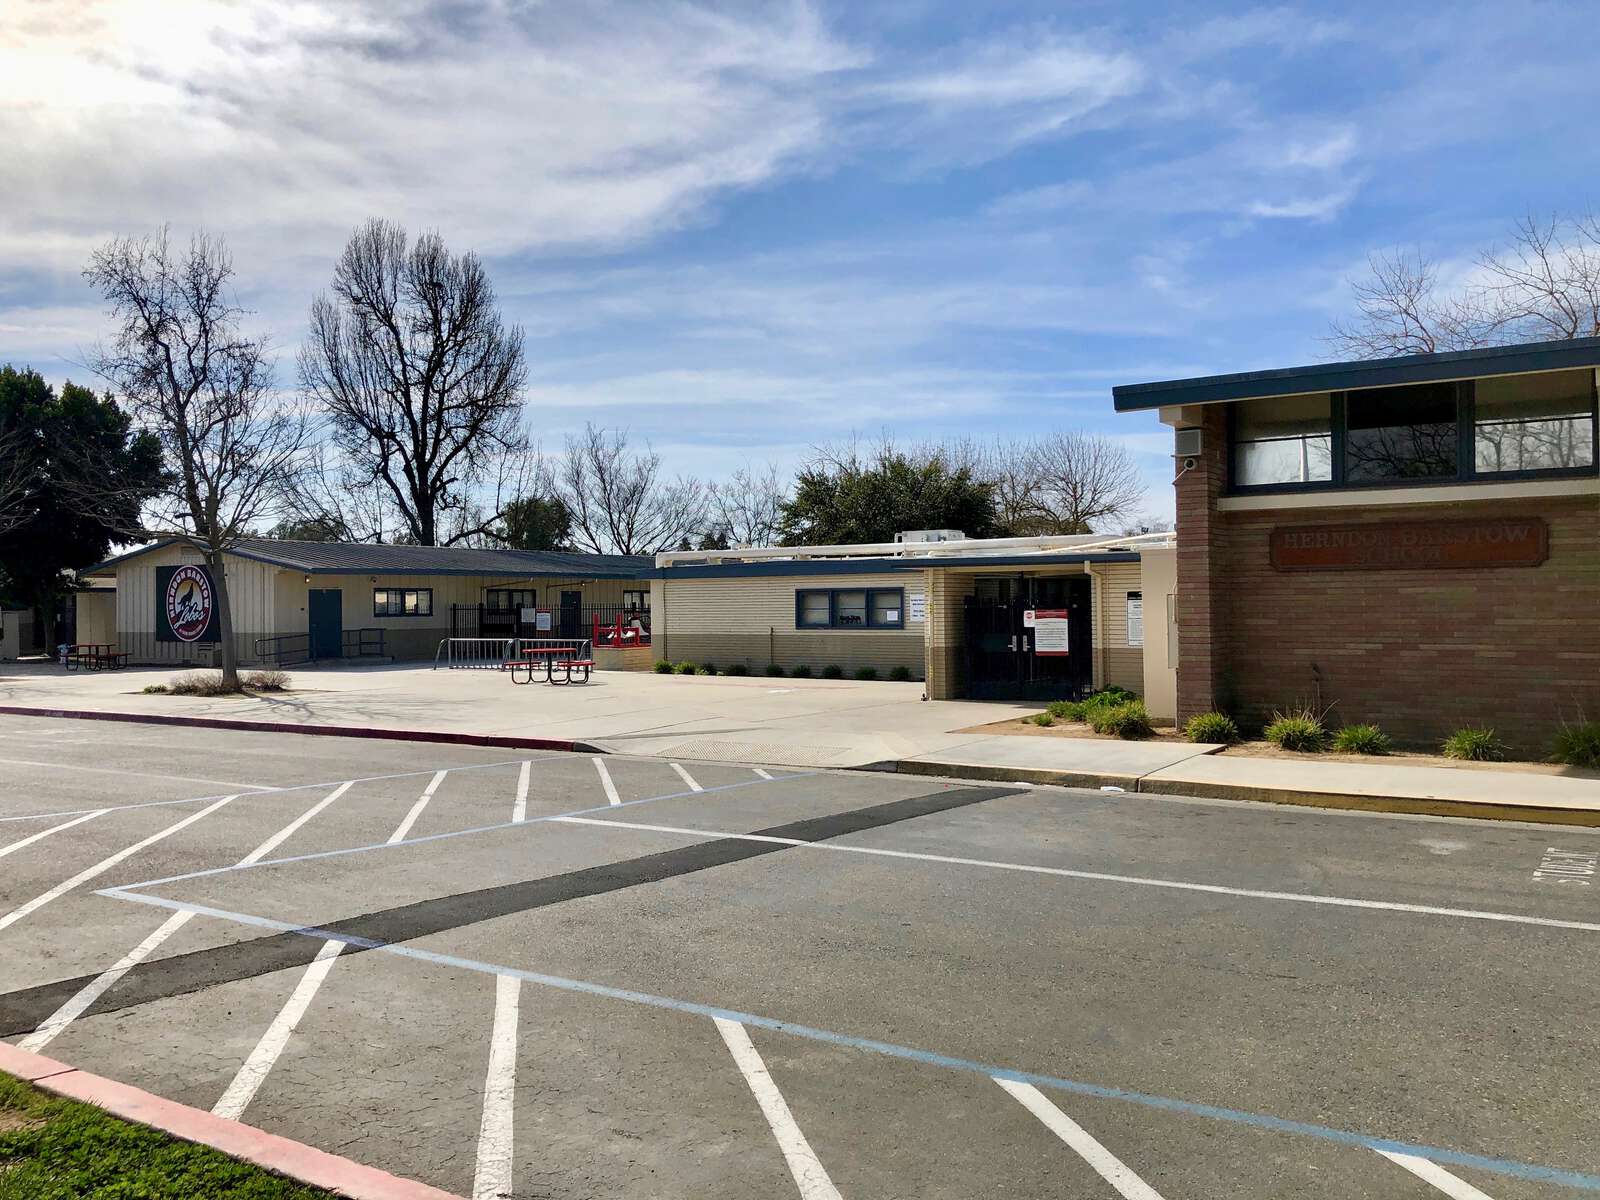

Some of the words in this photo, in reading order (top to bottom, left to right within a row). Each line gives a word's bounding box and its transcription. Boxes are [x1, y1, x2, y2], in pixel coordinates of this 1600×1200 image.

[169, 570, 186, 618] HERNDON
[187, 569, 209, 608] BARSTOW
[174, 602, 206, 629] Lobos
